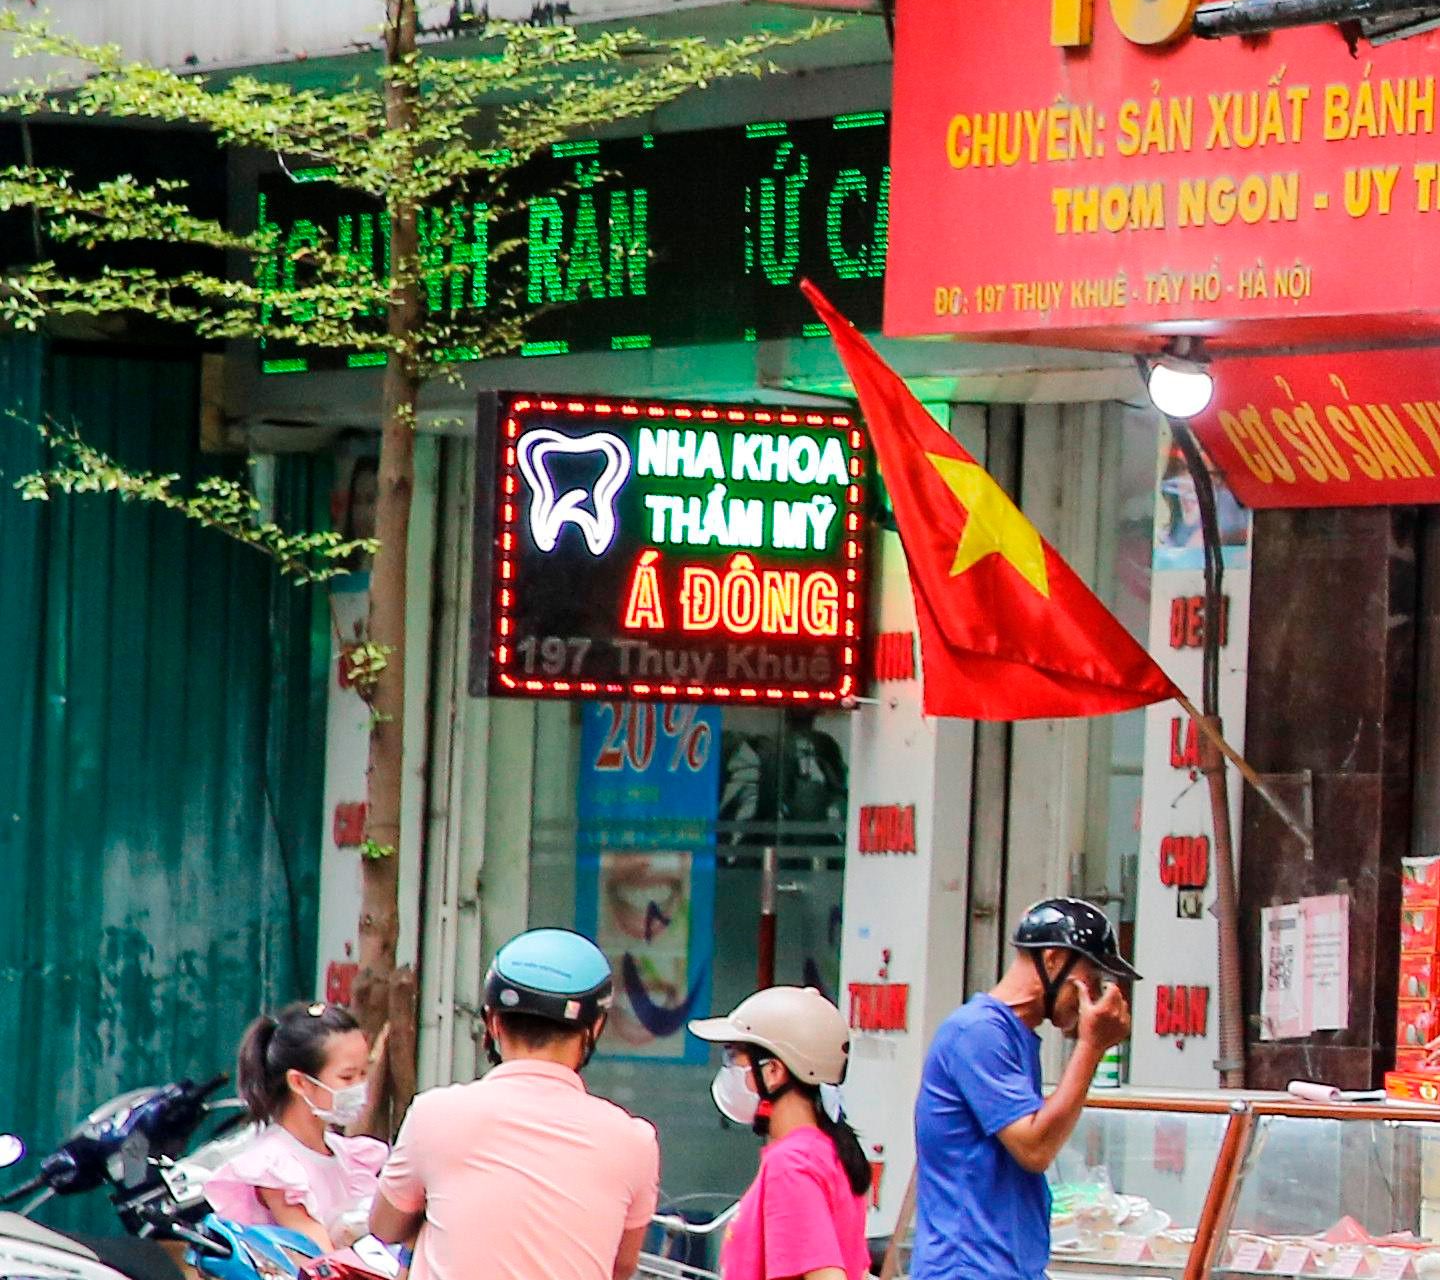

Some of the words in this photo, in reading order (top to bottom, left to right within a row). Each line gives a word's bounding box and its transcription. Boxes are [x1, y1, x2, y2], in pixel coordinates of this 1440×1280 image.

[946, 97, 1106, 170] CHUYÊN:
[1117, 79, 1194, 157] SẢN
[1206, 63, 1312, 148] XUẤT
[1323, 61, 1436, 142] BÁNH
[1178, 173, 1300, 227] NGON
[1344, 168, 1400, 218] UY
[976, 279, 1006, 312] 197
[1013, 275, 1064, 315] THỤY
[1071, 266, 1129, 308] KHUÊ
[1146, 264, 1185, 305] TÂY
[1189, 254, 1222, 303] HỒ
[1239, 265, 1270, 302] HÀ
[1275, 260, 1312, 303] NỘI
[637, 427, 726, 479] NHA
[731, 432, 851, 485] KHOA
[624, 549, 666, 630] Á
[679, 551, 840, 637] ĐÔNG
[517, 636, 593, 675] 197
[612, 638, 721, 687] Thụy
[727, 642, 833, 681] Khuê
[593, 701, 712, 773] 20%
[1160, 833, 1211, 889] CHO
